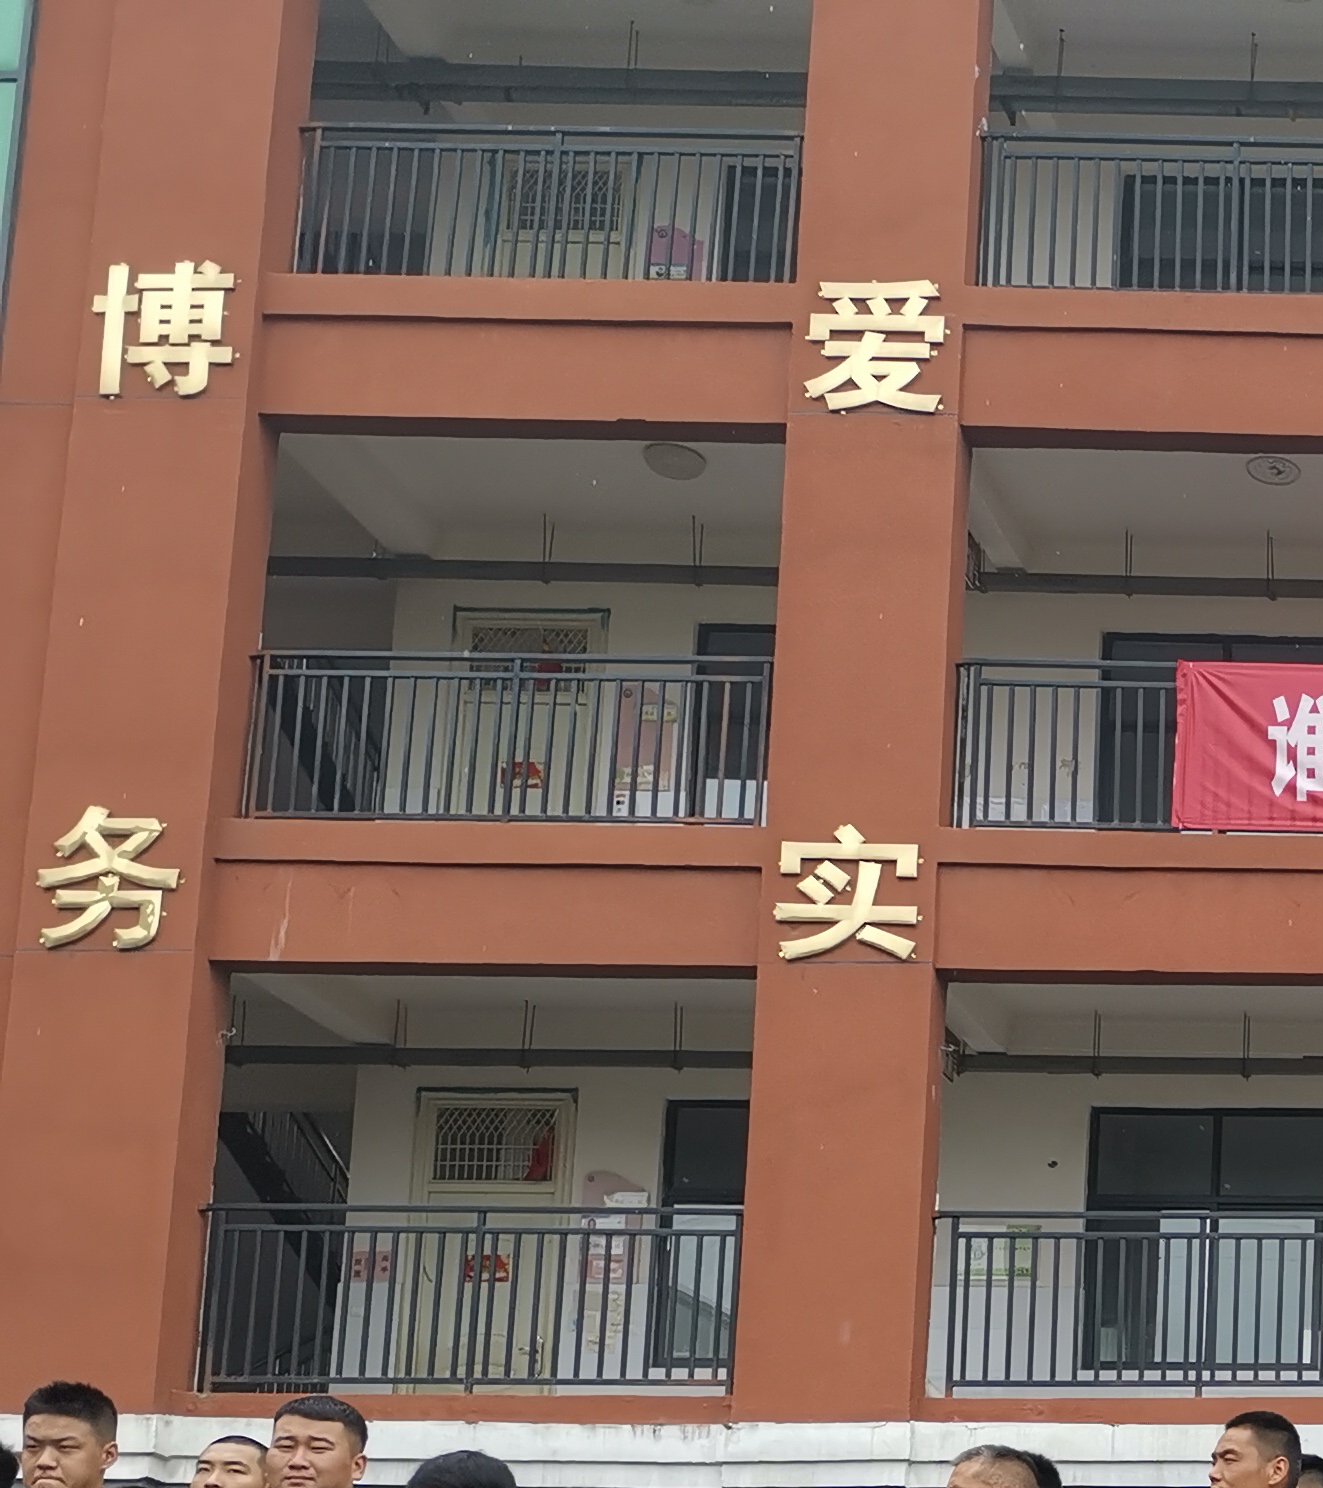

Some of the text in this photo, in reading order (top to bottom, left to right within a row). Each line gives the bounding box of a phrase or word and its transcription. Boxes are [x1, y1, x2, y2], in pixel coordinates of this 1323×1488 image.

[92, 260, 234, 395] 博
[804, 280, 944, 412] 爱
[38, 806, 180, 948] 务
[773, 824, 918, 960] 实
